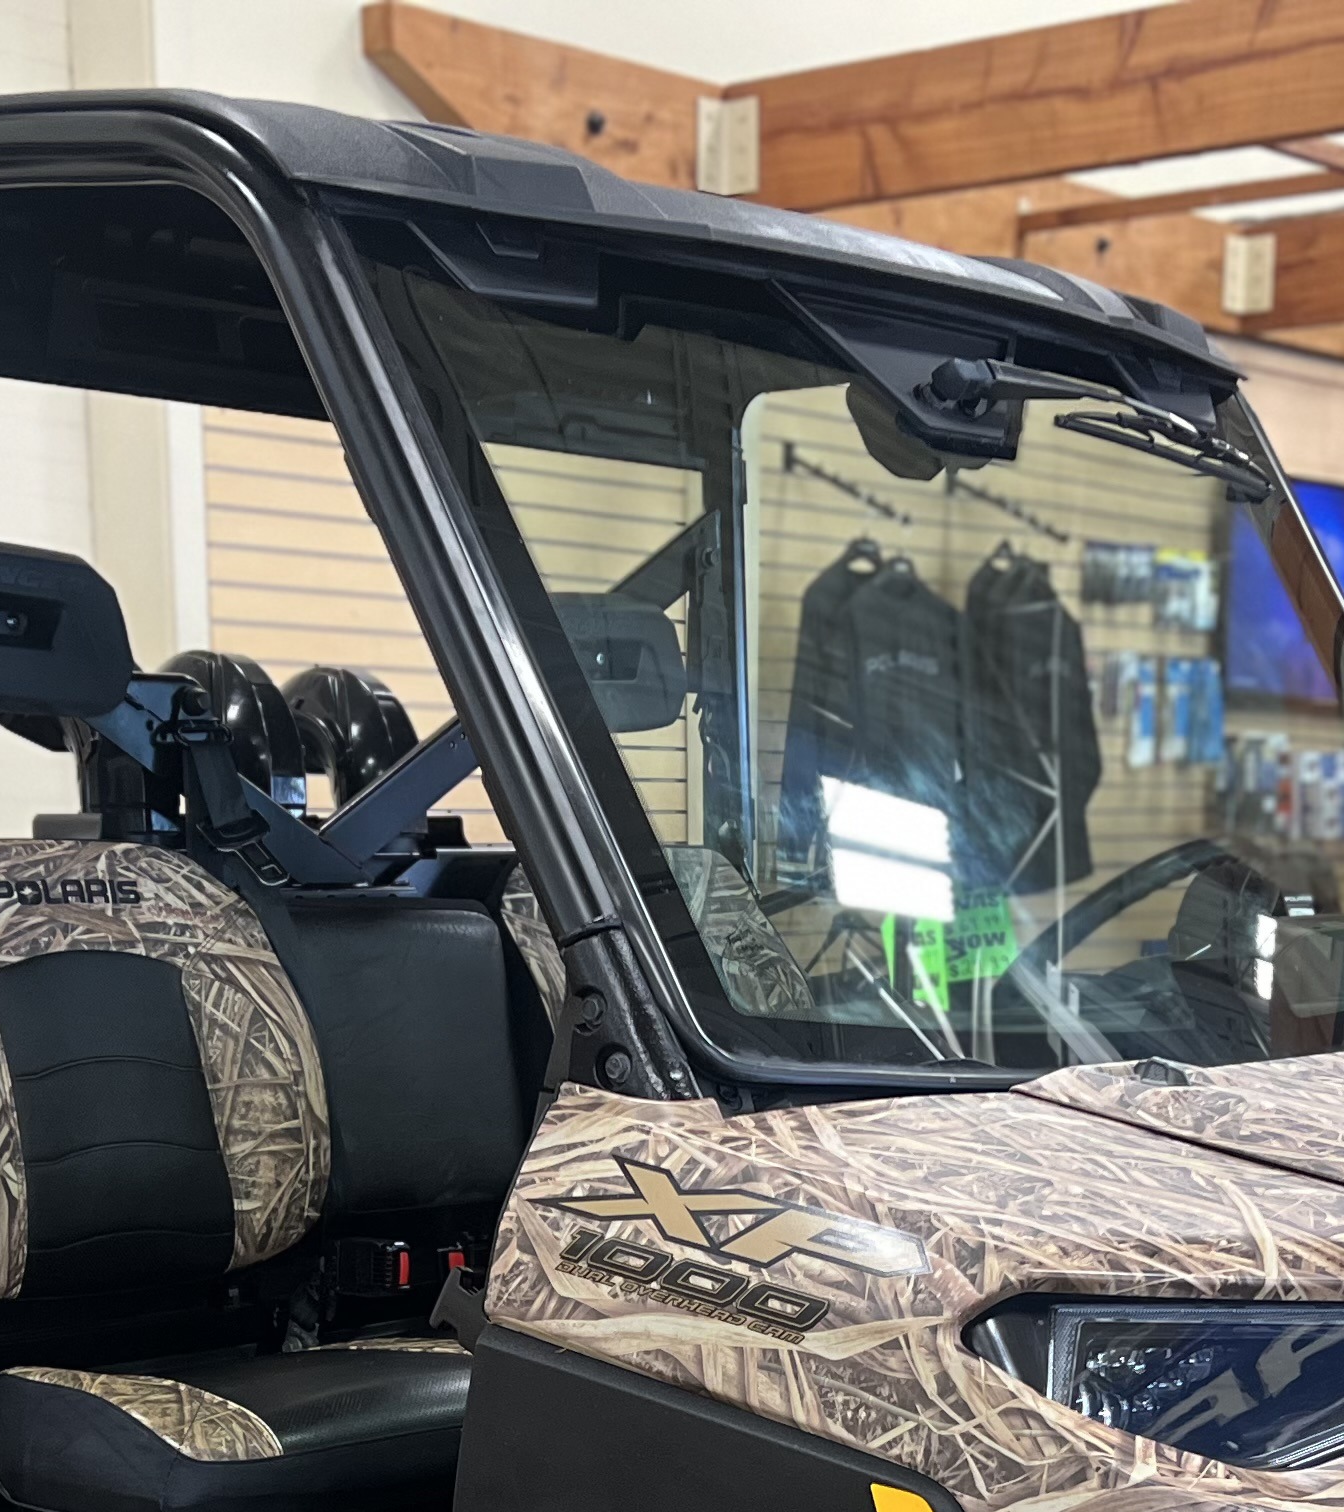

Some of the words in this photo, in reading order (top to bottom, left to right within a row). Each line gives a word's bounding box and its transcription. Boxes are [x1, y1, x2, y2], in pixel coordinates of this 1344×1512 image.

[526, 1153, 933, 1279] XP
[554, 1261, 617, 1288] DUAL
[619, 1280, 748, 1326] OVERHEAD
[747, 1320, 806, 1345] CAM
[560, 1227, 831, 1332] 1000
